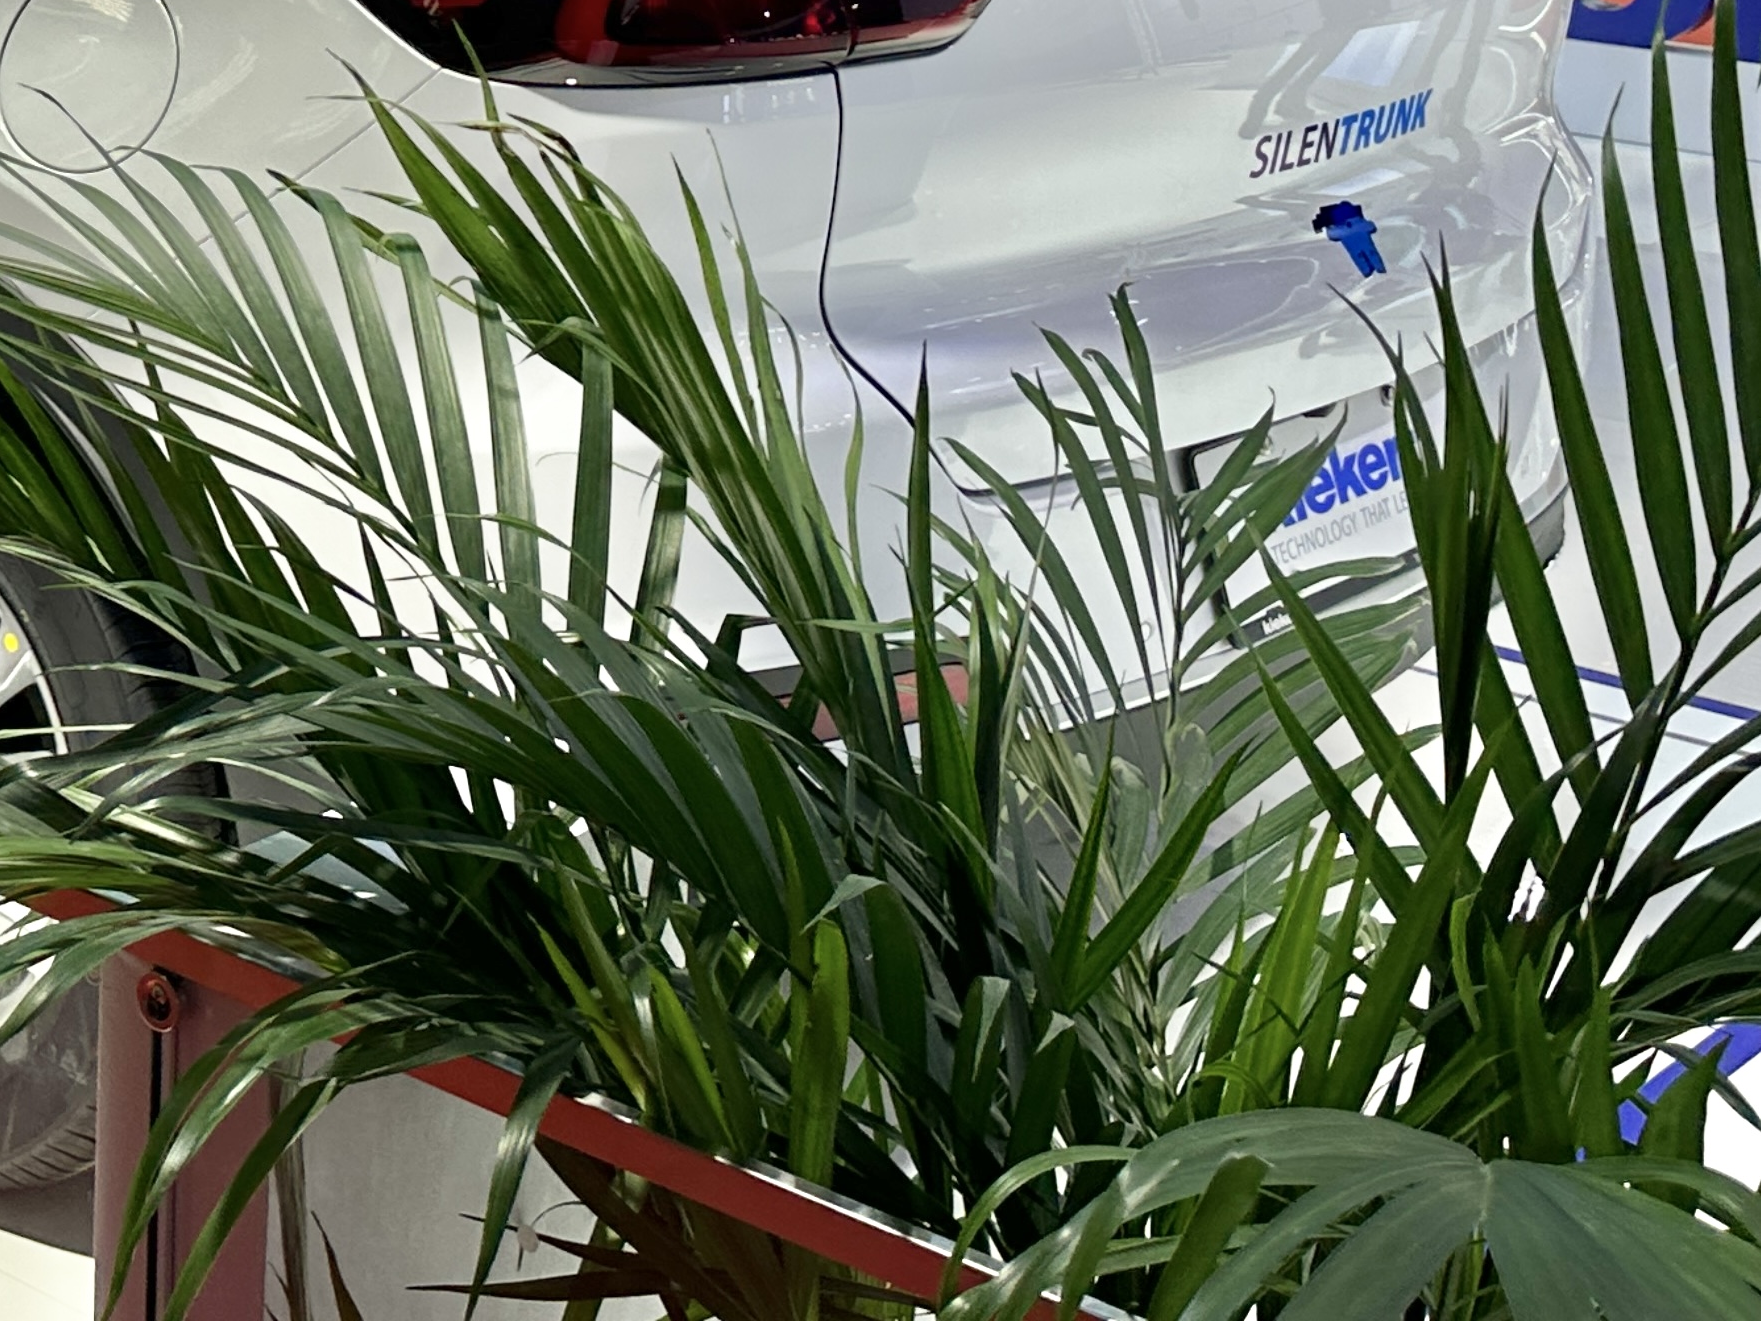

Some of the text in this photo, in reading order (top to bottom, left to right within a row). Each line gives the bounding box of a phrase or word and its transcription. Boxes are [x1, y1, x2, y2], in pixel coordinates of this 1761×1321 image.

[1249, 88, 1434, 179] SILENTRUNK
[1271, 512, 1360, 564] TECHNOLOGY
[1360, 496, 1393, 528] THAT
